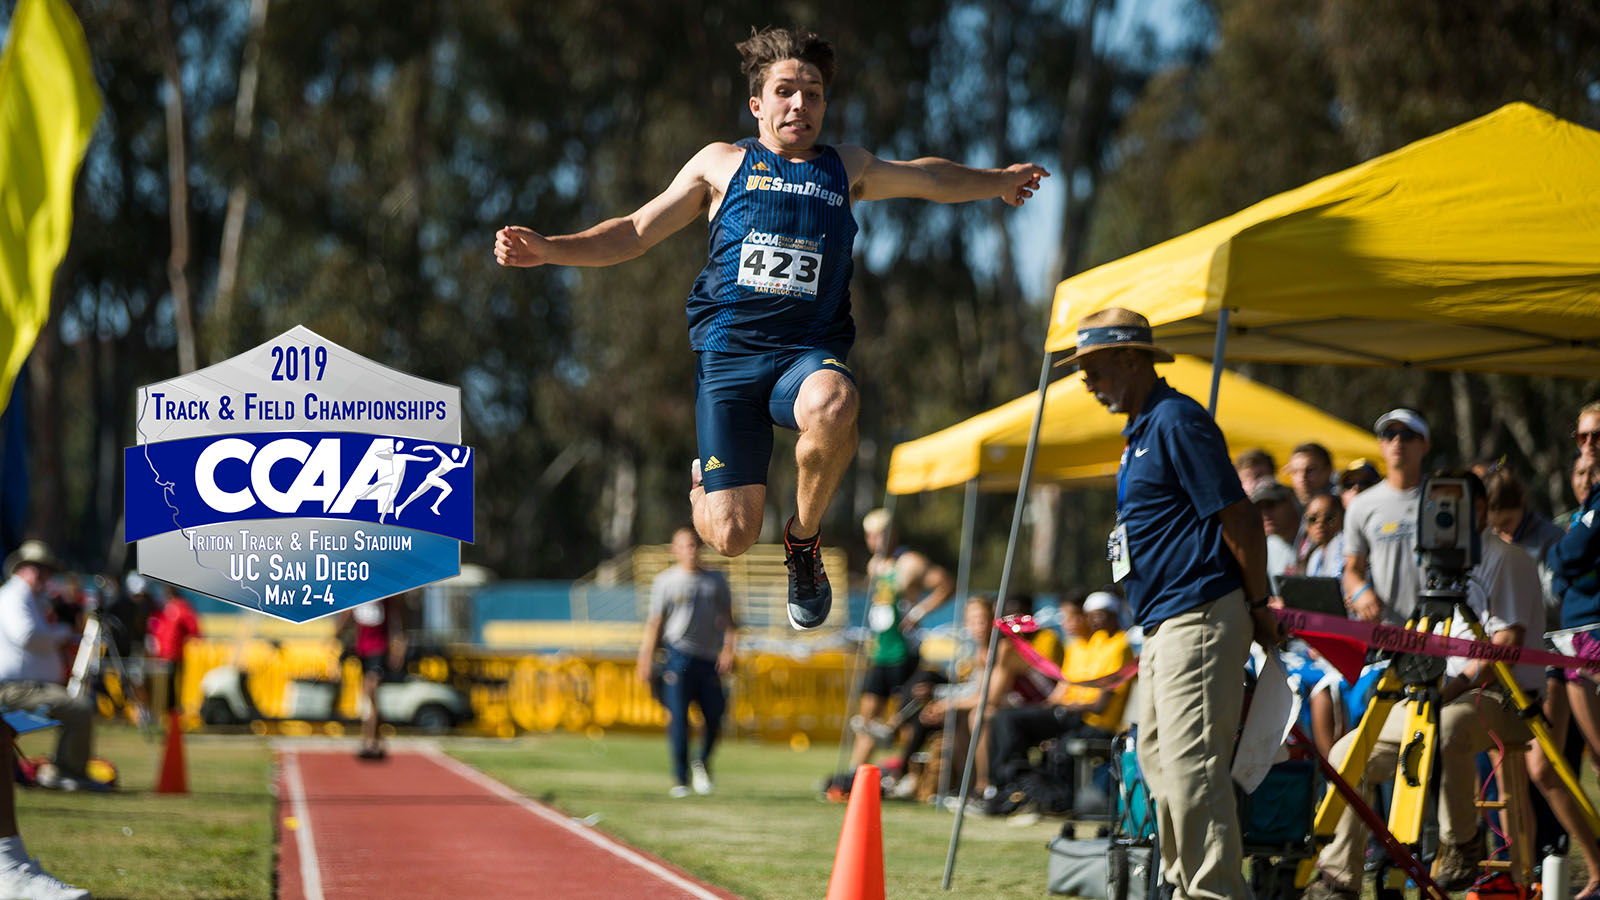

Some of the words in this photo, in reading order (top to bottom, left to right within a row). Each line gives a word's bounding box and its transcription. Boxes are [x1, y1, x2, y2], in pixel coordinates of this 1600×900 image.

[752, 232, 778, 247] CCAA
[778, 235, 794, 243] TRACK
[743, 249, 818, 283] 423
[754, 286, 768, 294] SAN
